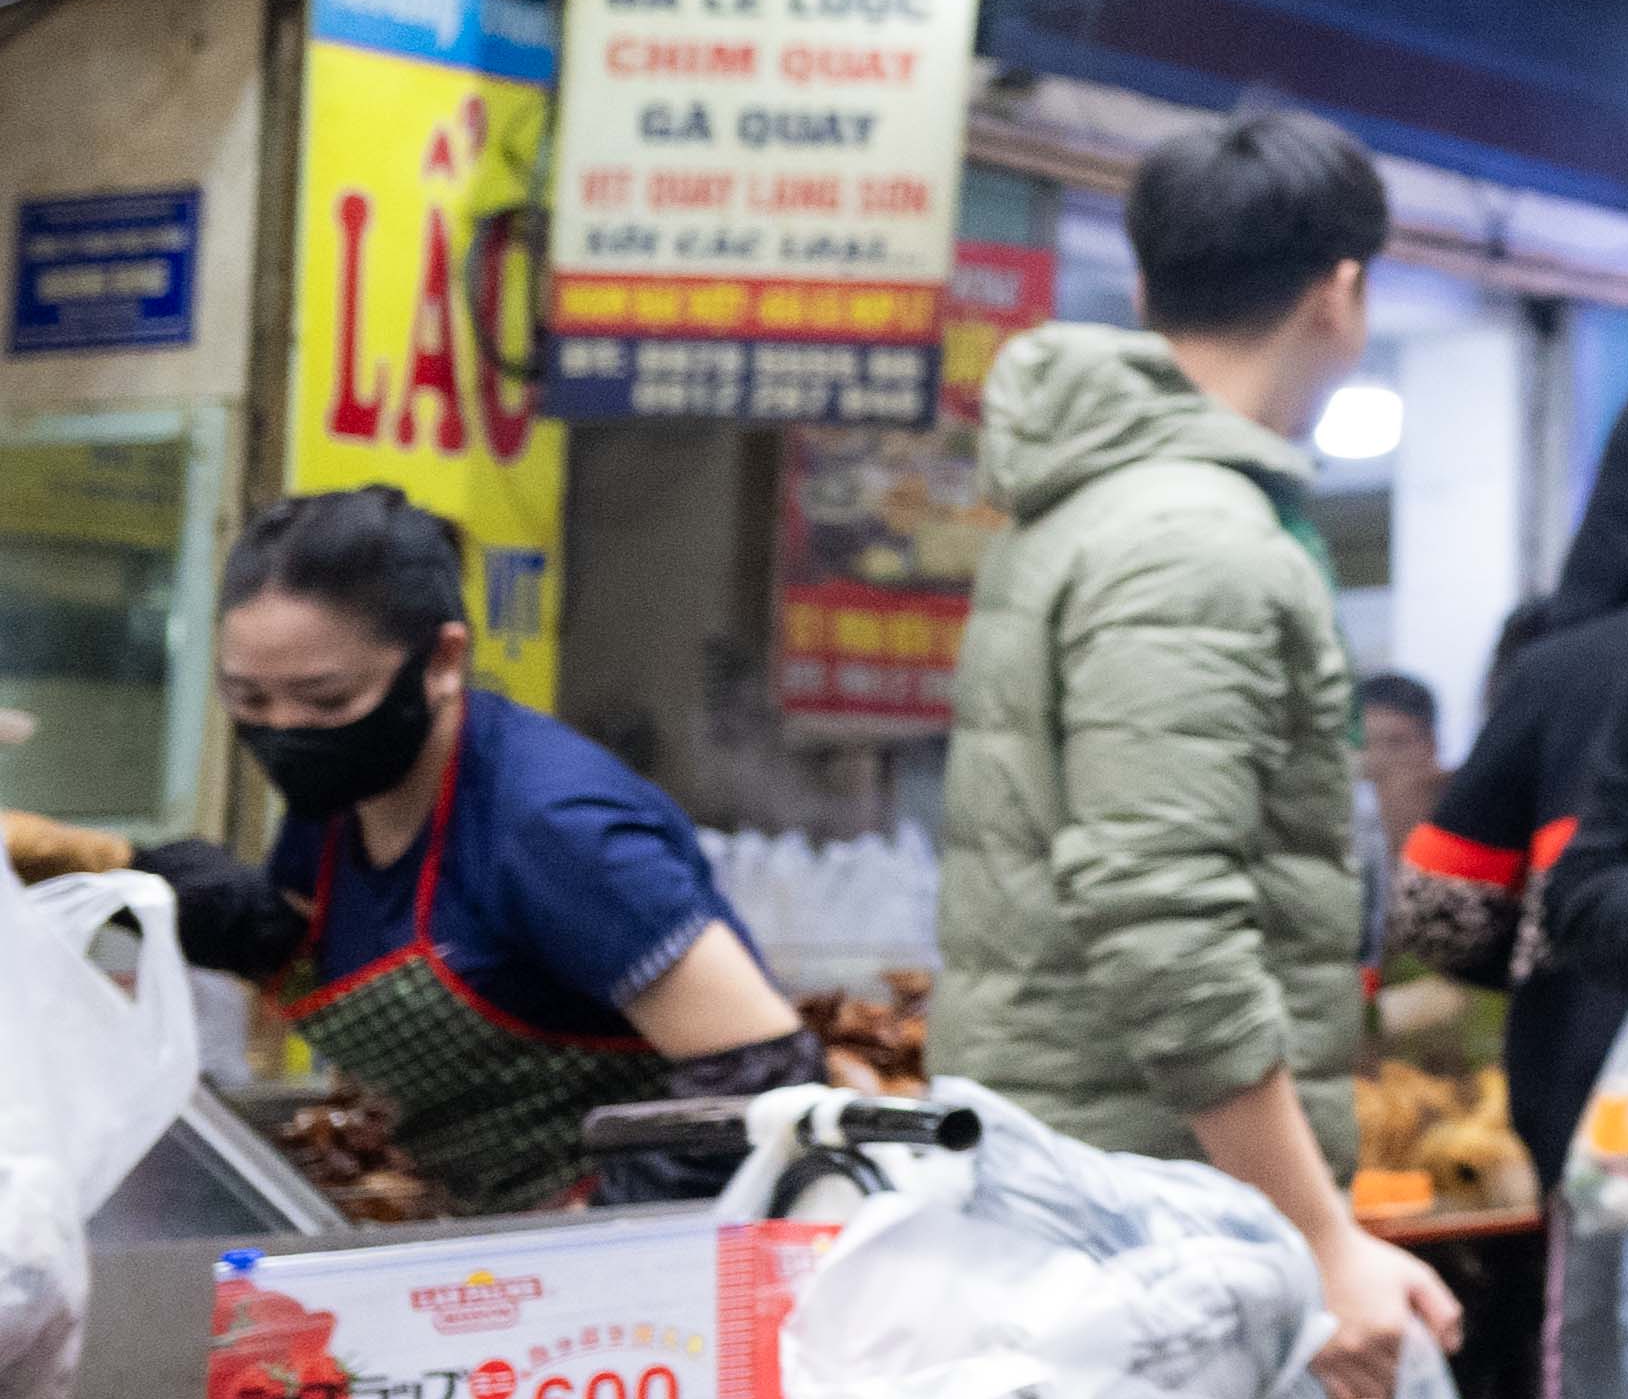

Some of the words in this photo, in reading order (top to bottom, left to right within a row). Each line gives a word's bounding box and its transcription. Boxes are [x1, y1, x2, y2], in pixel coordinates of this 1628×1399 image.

[605, 40, 758, 78] CHIM
[779, 44, 918, 84] QUAY
[736, 111, 876, 147] QUAY
